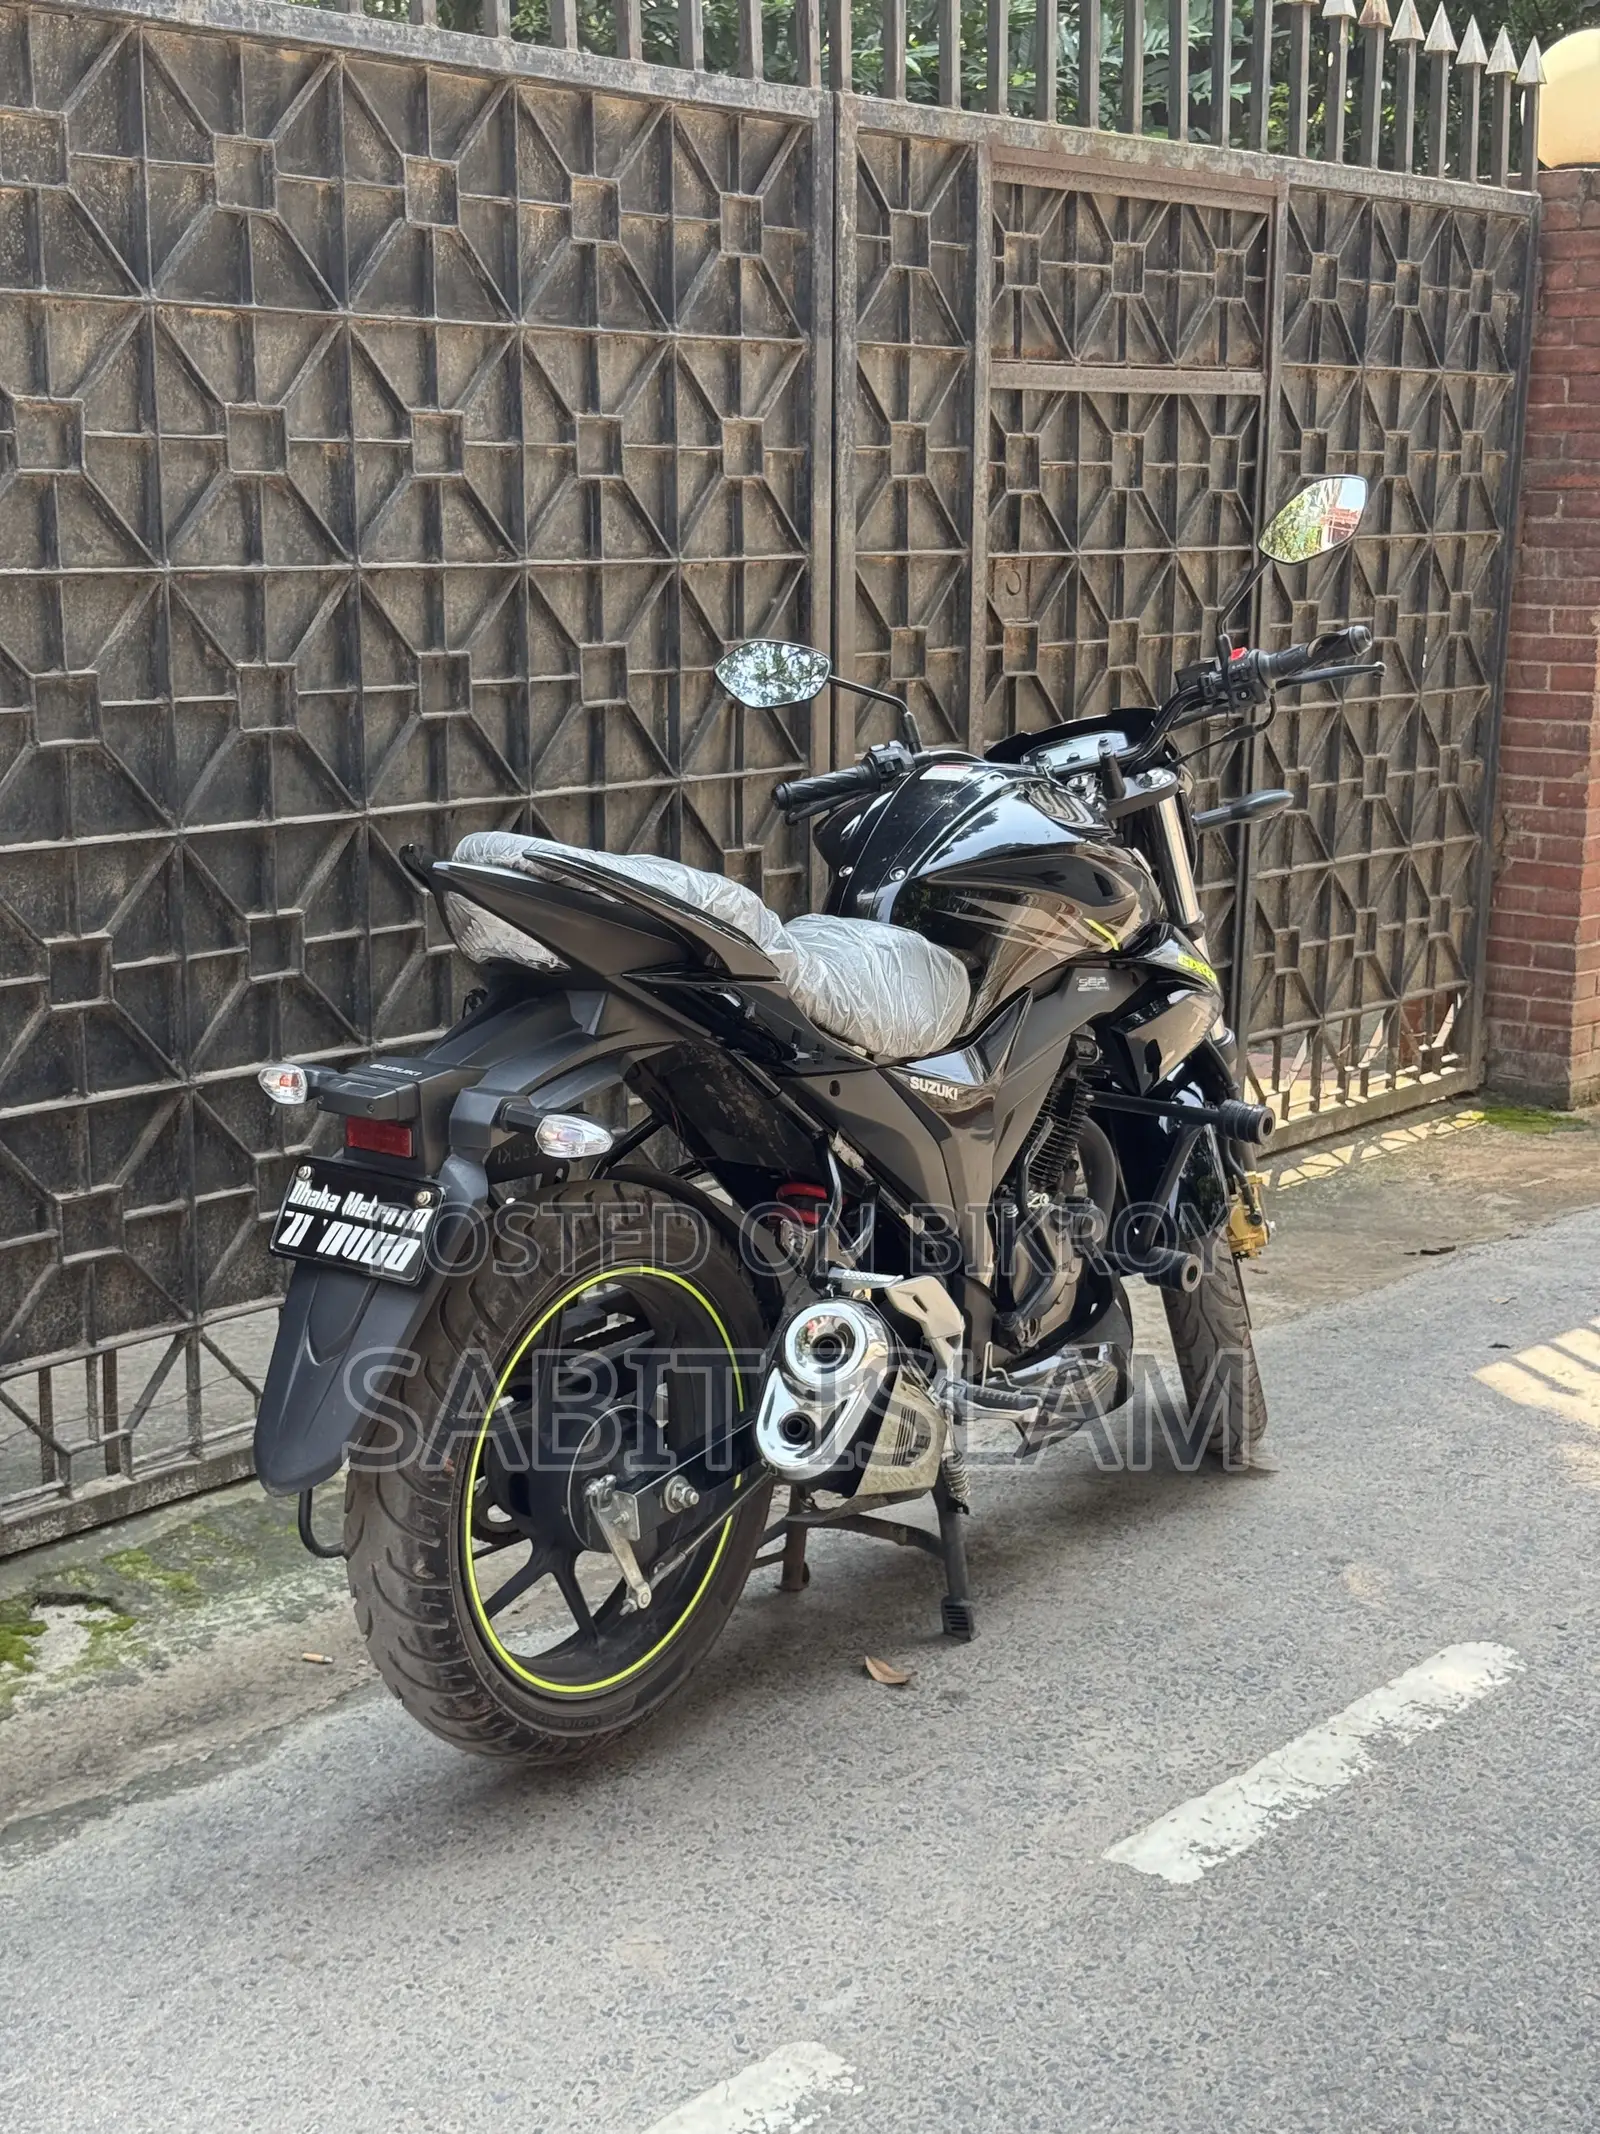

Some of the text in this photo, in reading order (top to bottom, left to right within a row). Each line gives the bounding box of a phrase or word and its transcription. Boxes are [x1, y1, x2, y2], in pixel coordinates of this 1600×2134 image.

[369, 1063, 422, 1077] SUZUKI
[909, 1076, 958, 1101] SUZUKI
[288, 1179, 342, 1212] Dhaka
